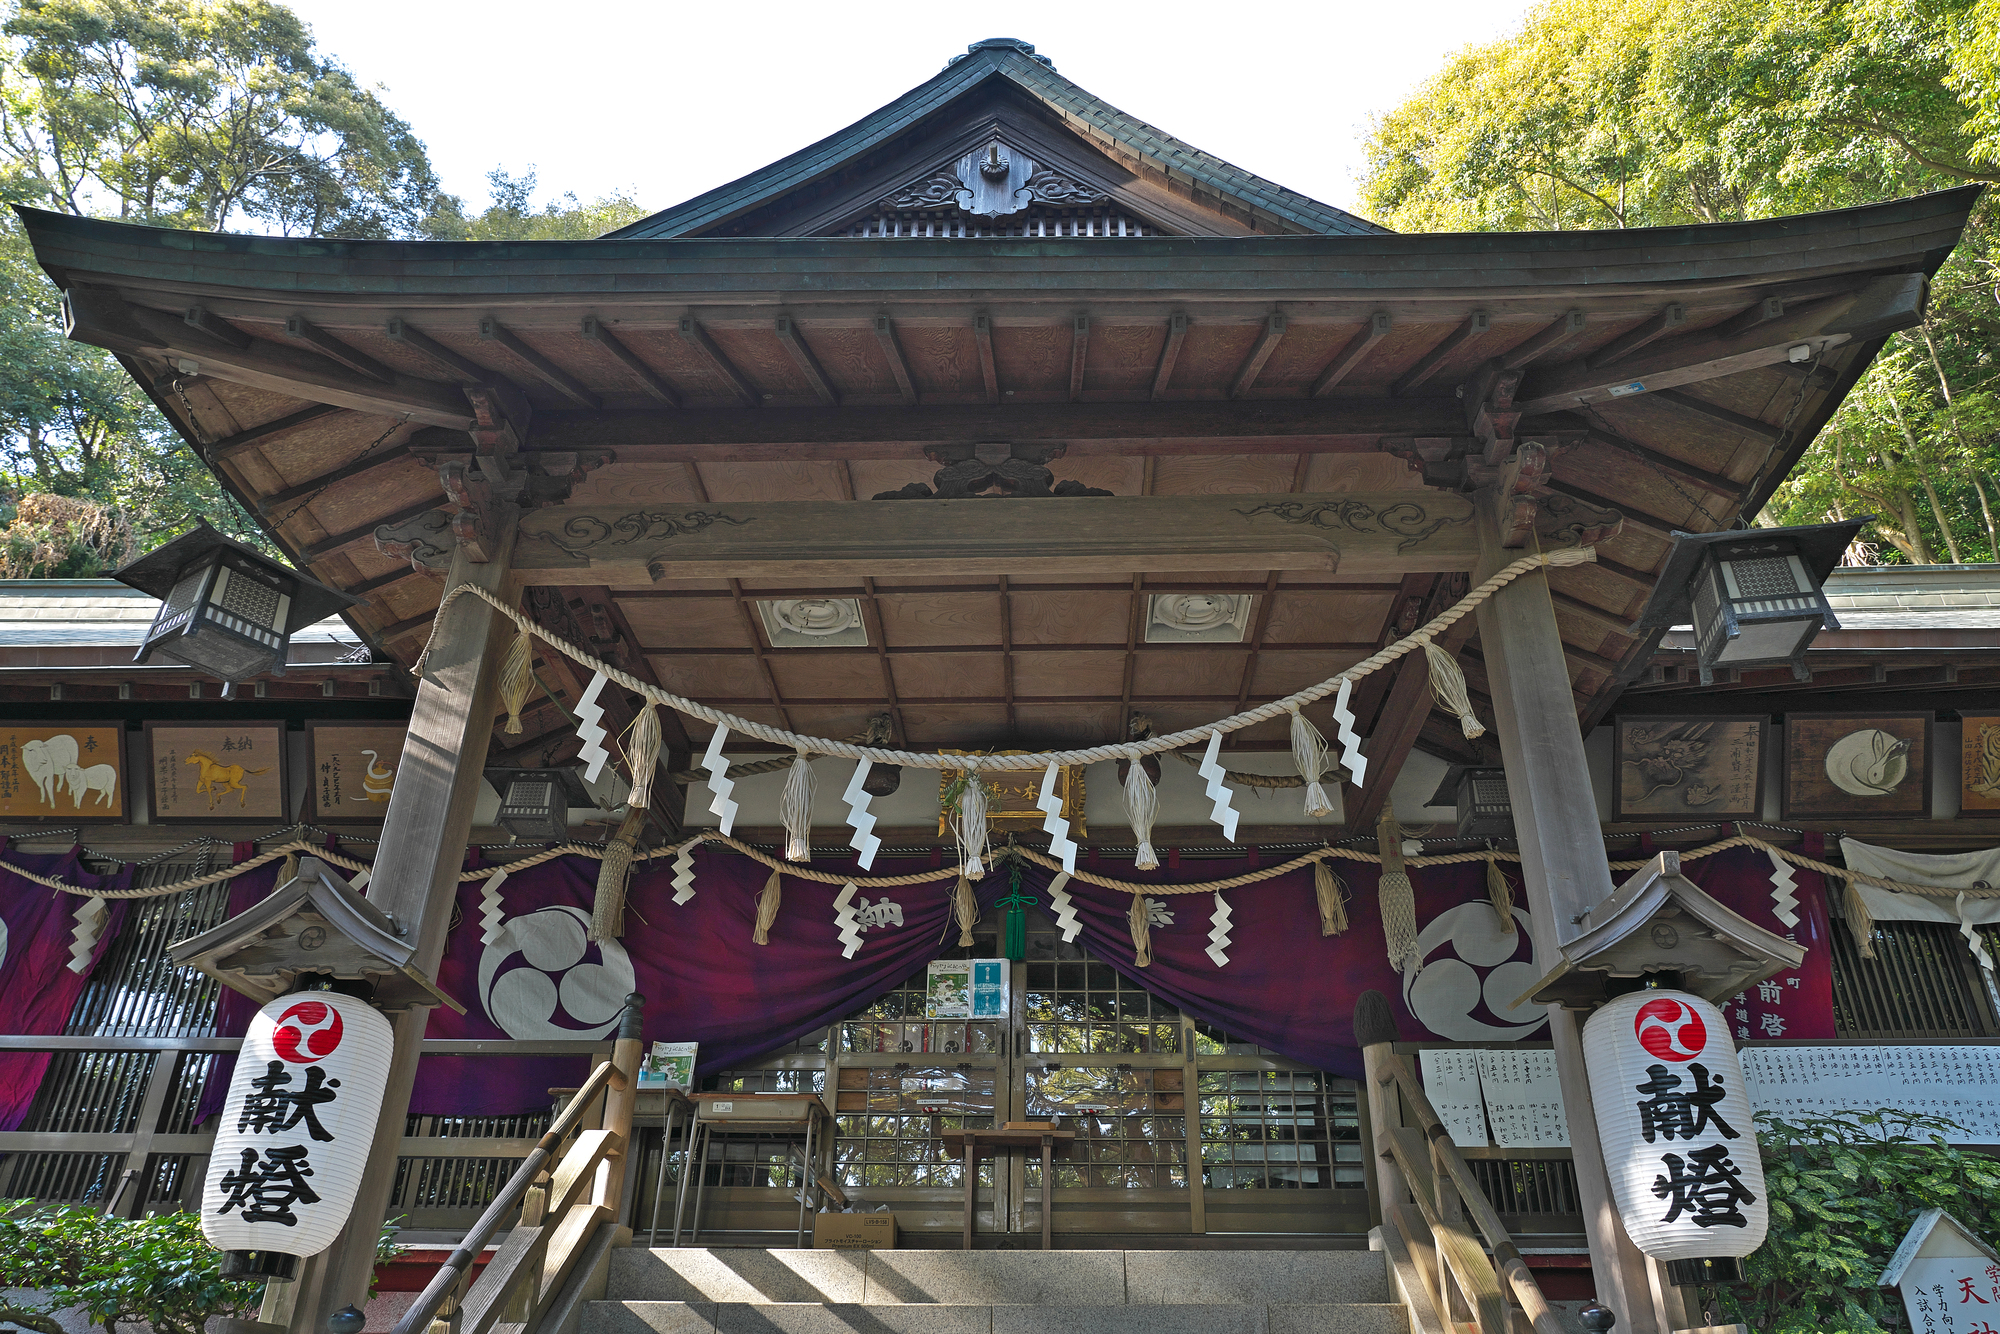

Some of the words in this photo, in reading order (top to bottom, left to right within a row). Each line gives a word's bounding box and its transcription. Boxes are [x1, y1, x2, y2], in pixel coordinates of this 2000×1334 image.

[83, 735, 98, 753] 奉
[221, 735, 253, 752] 奉納
[217, 1060, 341, 1227] 献燈
[1635, 1062, 1757, 1228] 献燈
